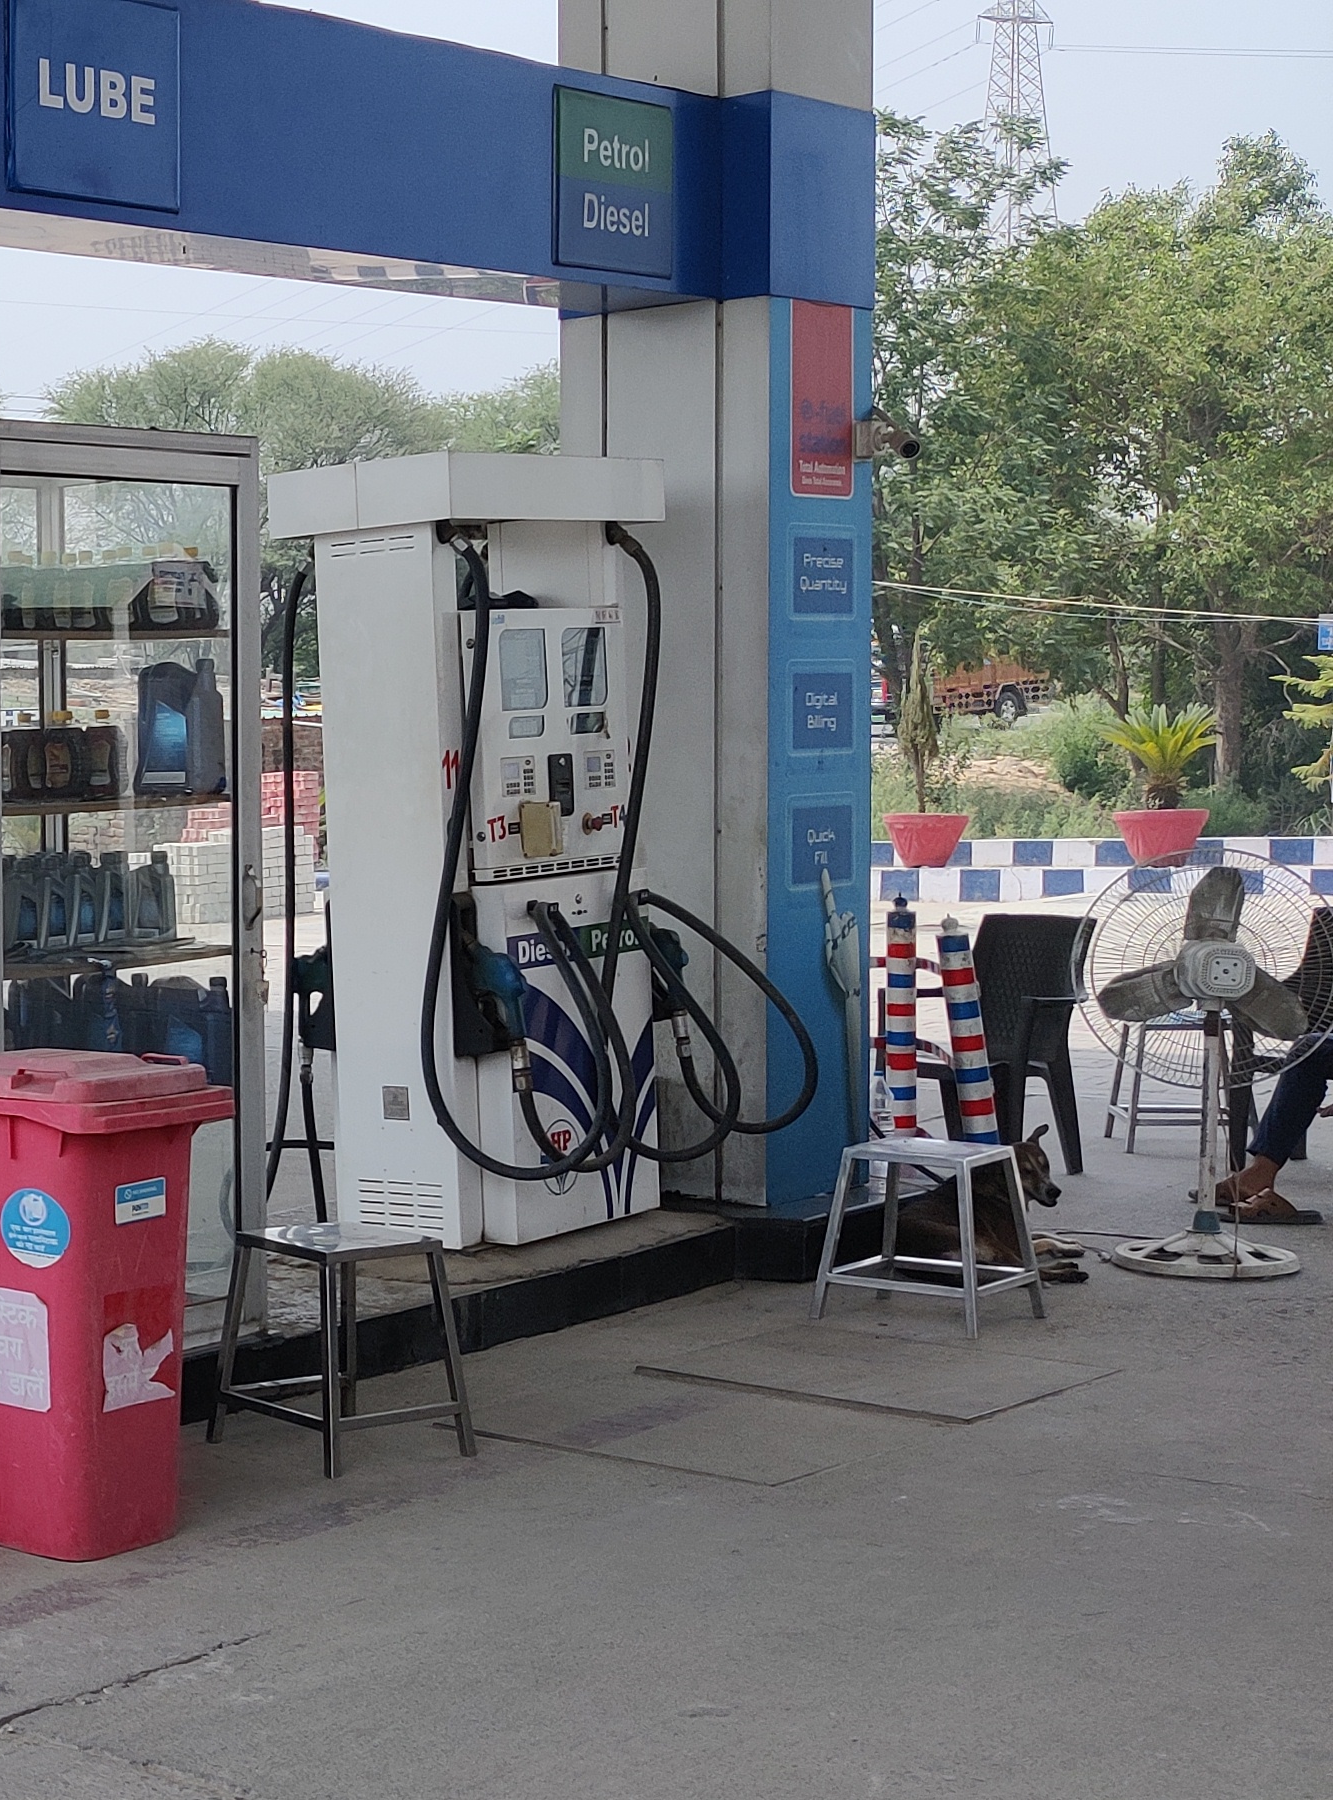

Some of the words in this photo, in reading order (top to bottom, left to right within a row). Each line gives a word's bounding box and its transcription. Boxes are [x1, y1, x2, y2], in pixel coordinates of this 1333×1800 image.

[38, 58, 156, 125] LUBE
[583, 128, 649, 173] Petrol
[583, 193, 649, 237] Diesel
[803, 553, 844, 568] Precise
[800, 576, 847, 594] Quantity
[805, 692, 838, 709] Digital
[807, 715, 837, 732] Billing
[487, 815, 507, 843] T3
[807, 829, 836, 846] Quick
[814, 851, 828, 865] Fill
[551, 1129, 572, 1151] HP
[6, 1367, 46, 1400] डालें
